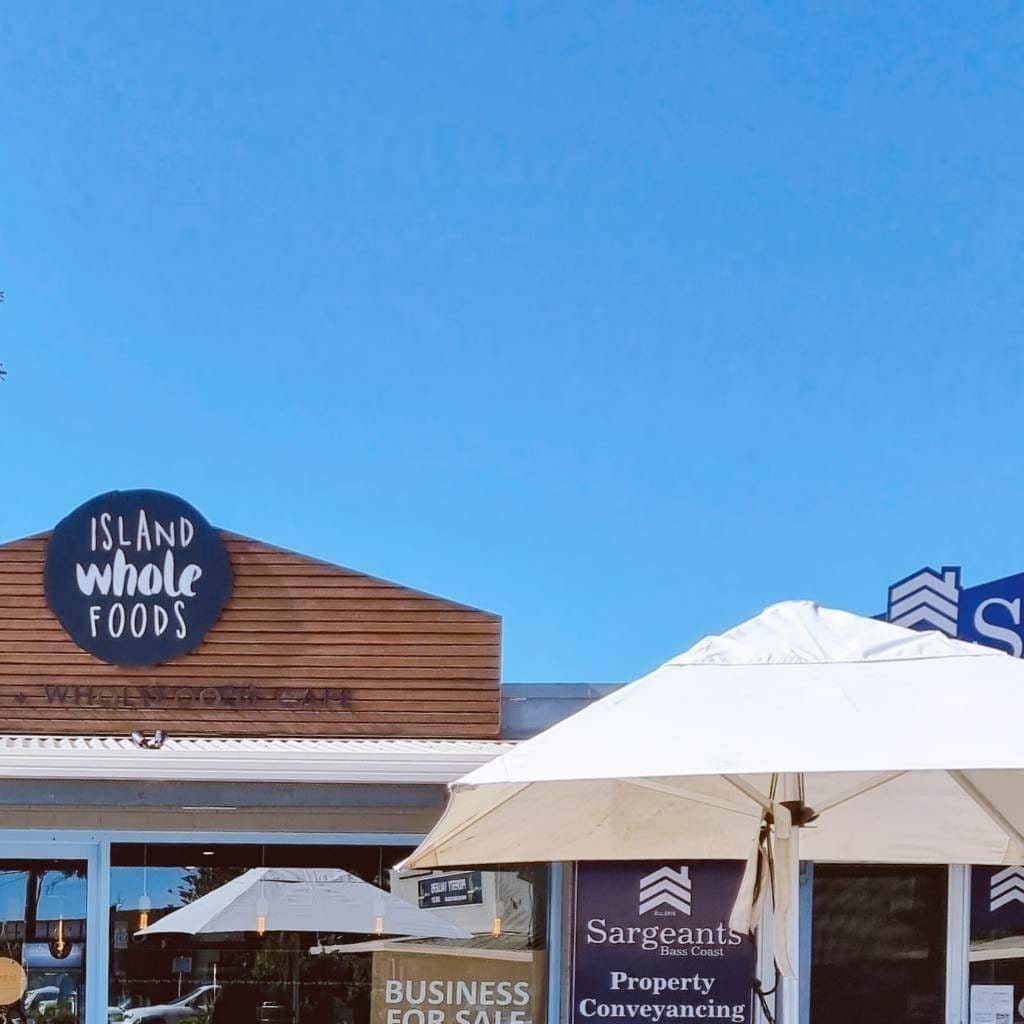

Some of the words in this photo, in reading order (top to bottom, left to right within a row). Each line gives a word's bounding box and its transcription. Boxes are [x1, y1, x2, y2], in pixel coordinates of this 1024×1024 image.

[91, 509, 194, 551] ISLAND
[76, 548, 203, 597] whole
[89, 600, 187, 639] FOODS
[587, 918, 742, 950] Sargeants
[660, 946, 688, 956] Bass
[691, 946, 724, 957] Coast
[384, 980, 530, 1006] BUSINESS
[610, 971, 715, 994] Property
[579, 998, 746, 1023] Conveyancing
